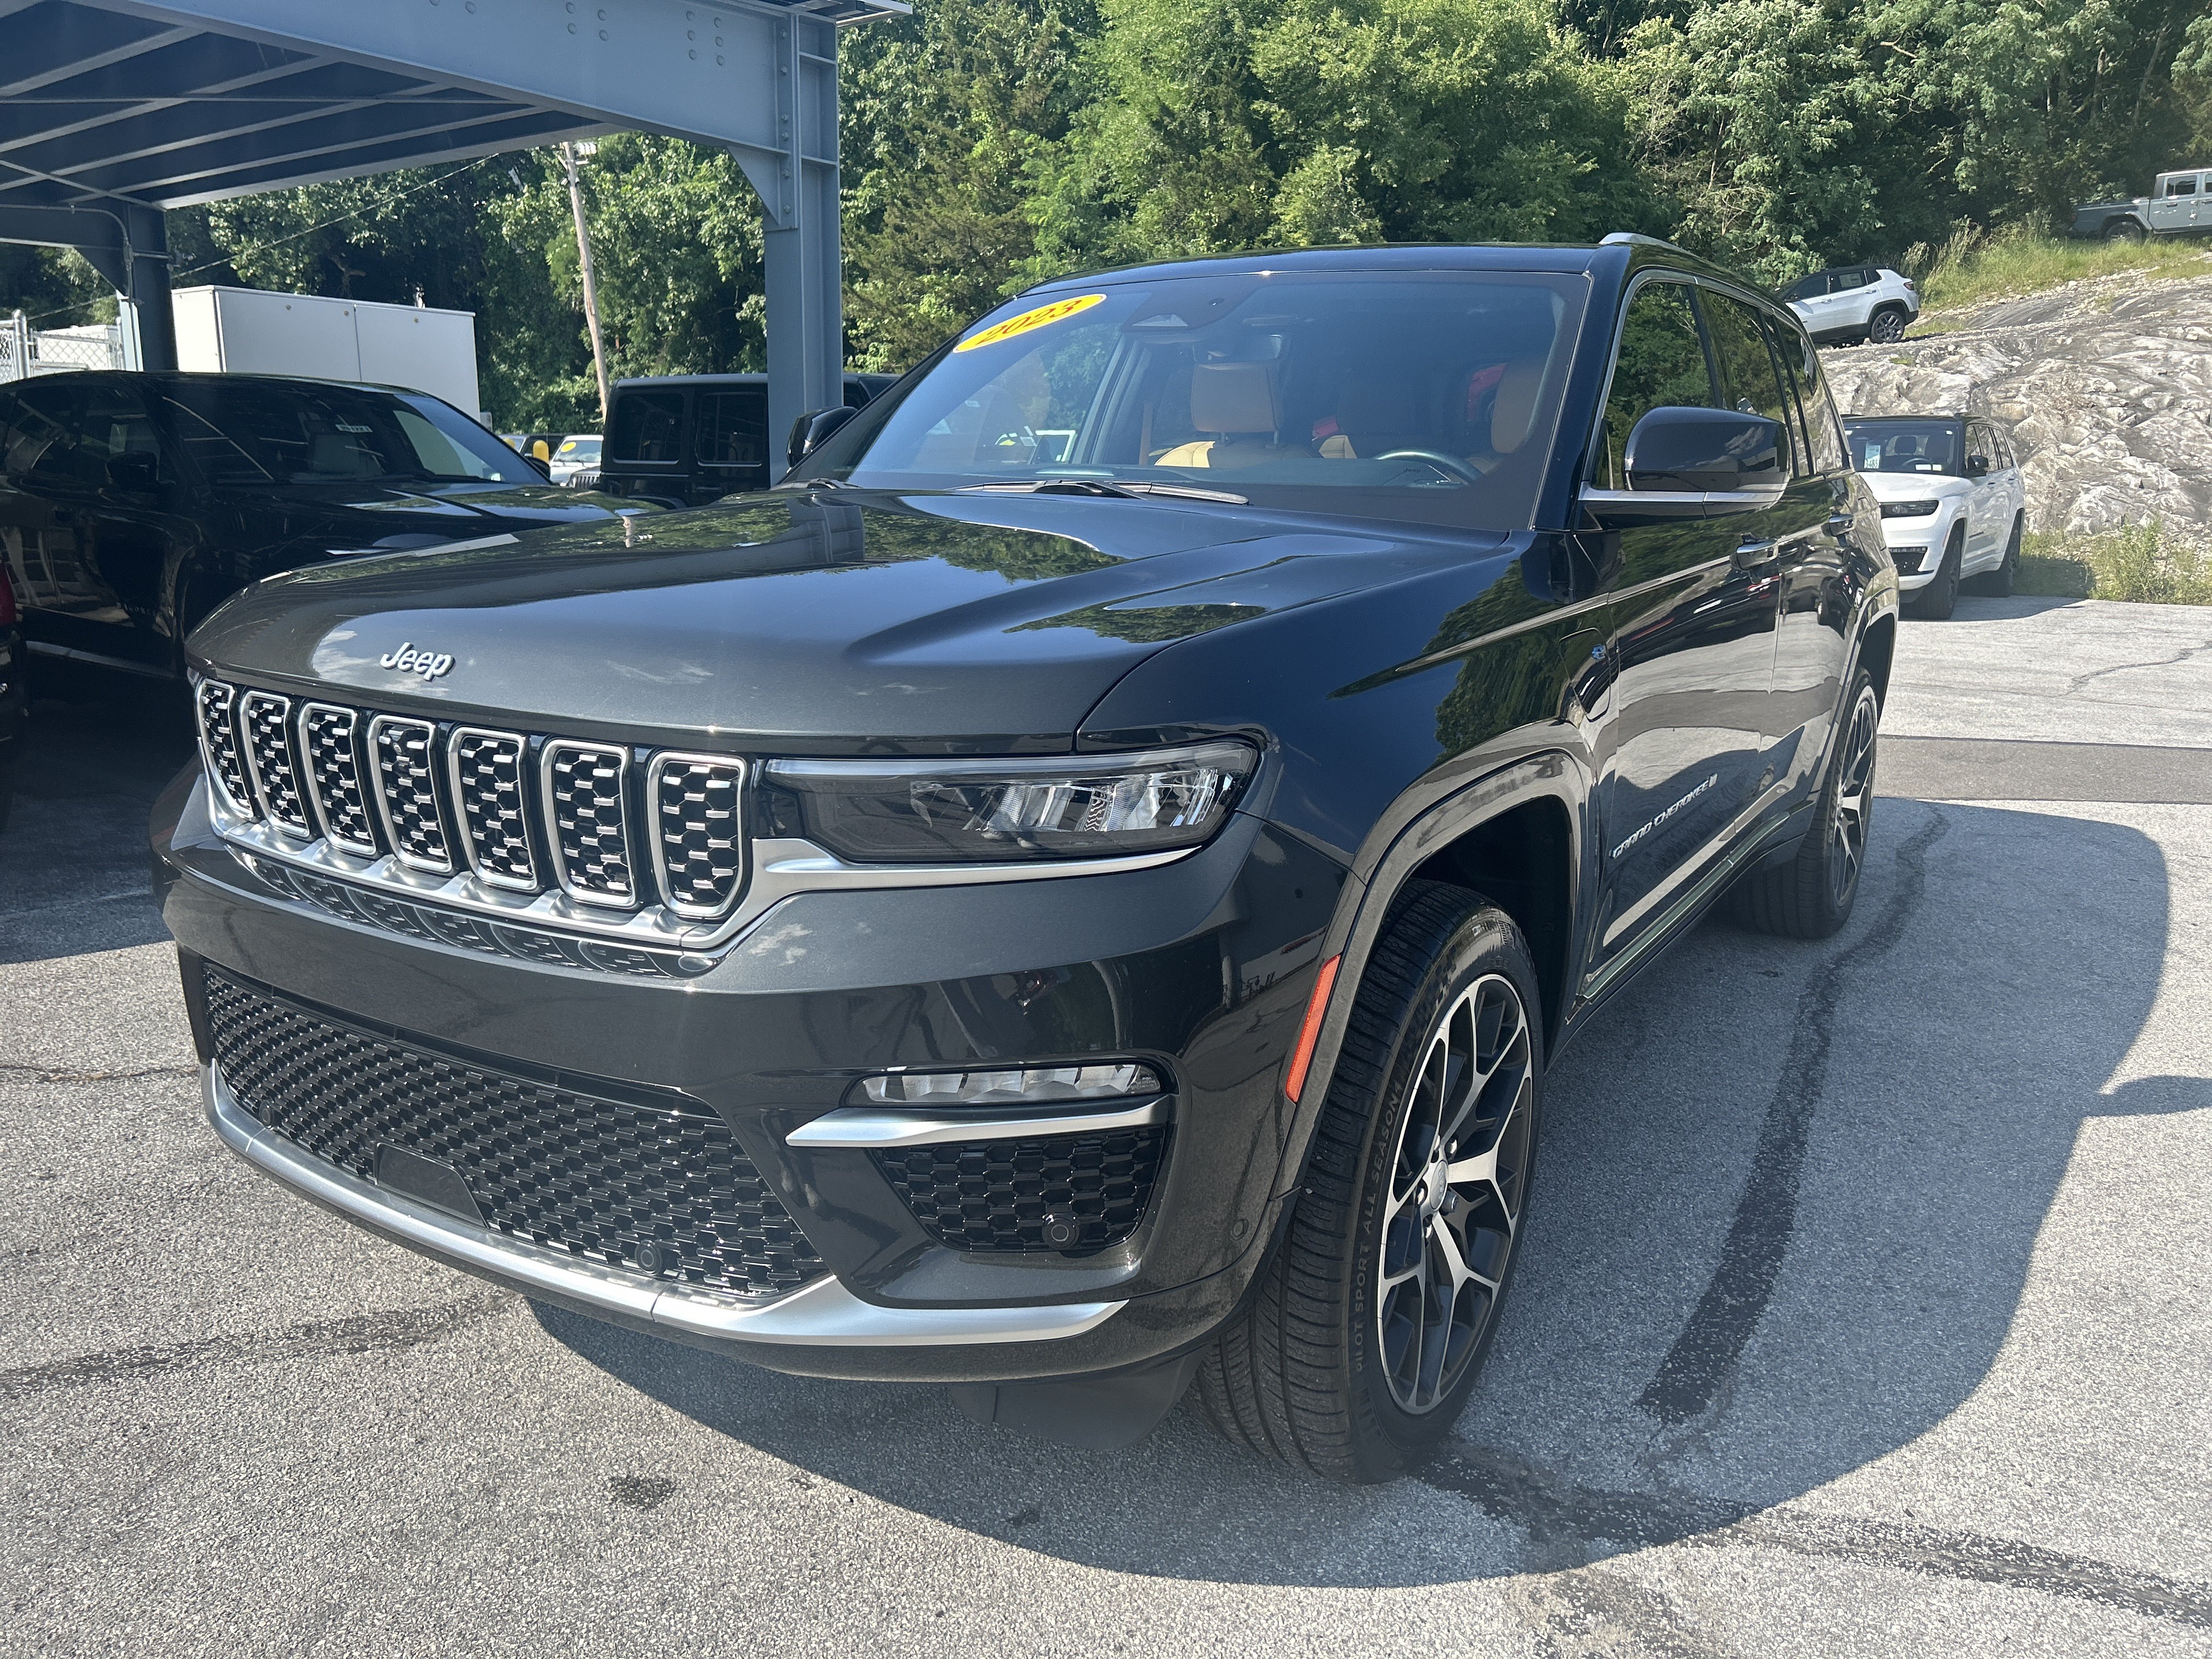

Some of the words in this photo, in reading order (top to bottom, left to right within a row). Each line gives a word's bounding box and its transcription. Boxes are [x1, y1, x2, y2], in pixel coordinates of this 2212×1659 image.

[975, 300, 1081, 345] 2023
[380, 642, 454, 681] Jeep
[1610, 822, 1652, 859] GRAND
[1654, 780, 1709, 826] CHEROKEE
[1371, 1092, 1398, 1183] SEASON
[1363, 1193, 1376, 1234] ALL
[1355, 1242, 1369, 1312] SPORT
[1355, 1321, 1363, 1372] PILOT
